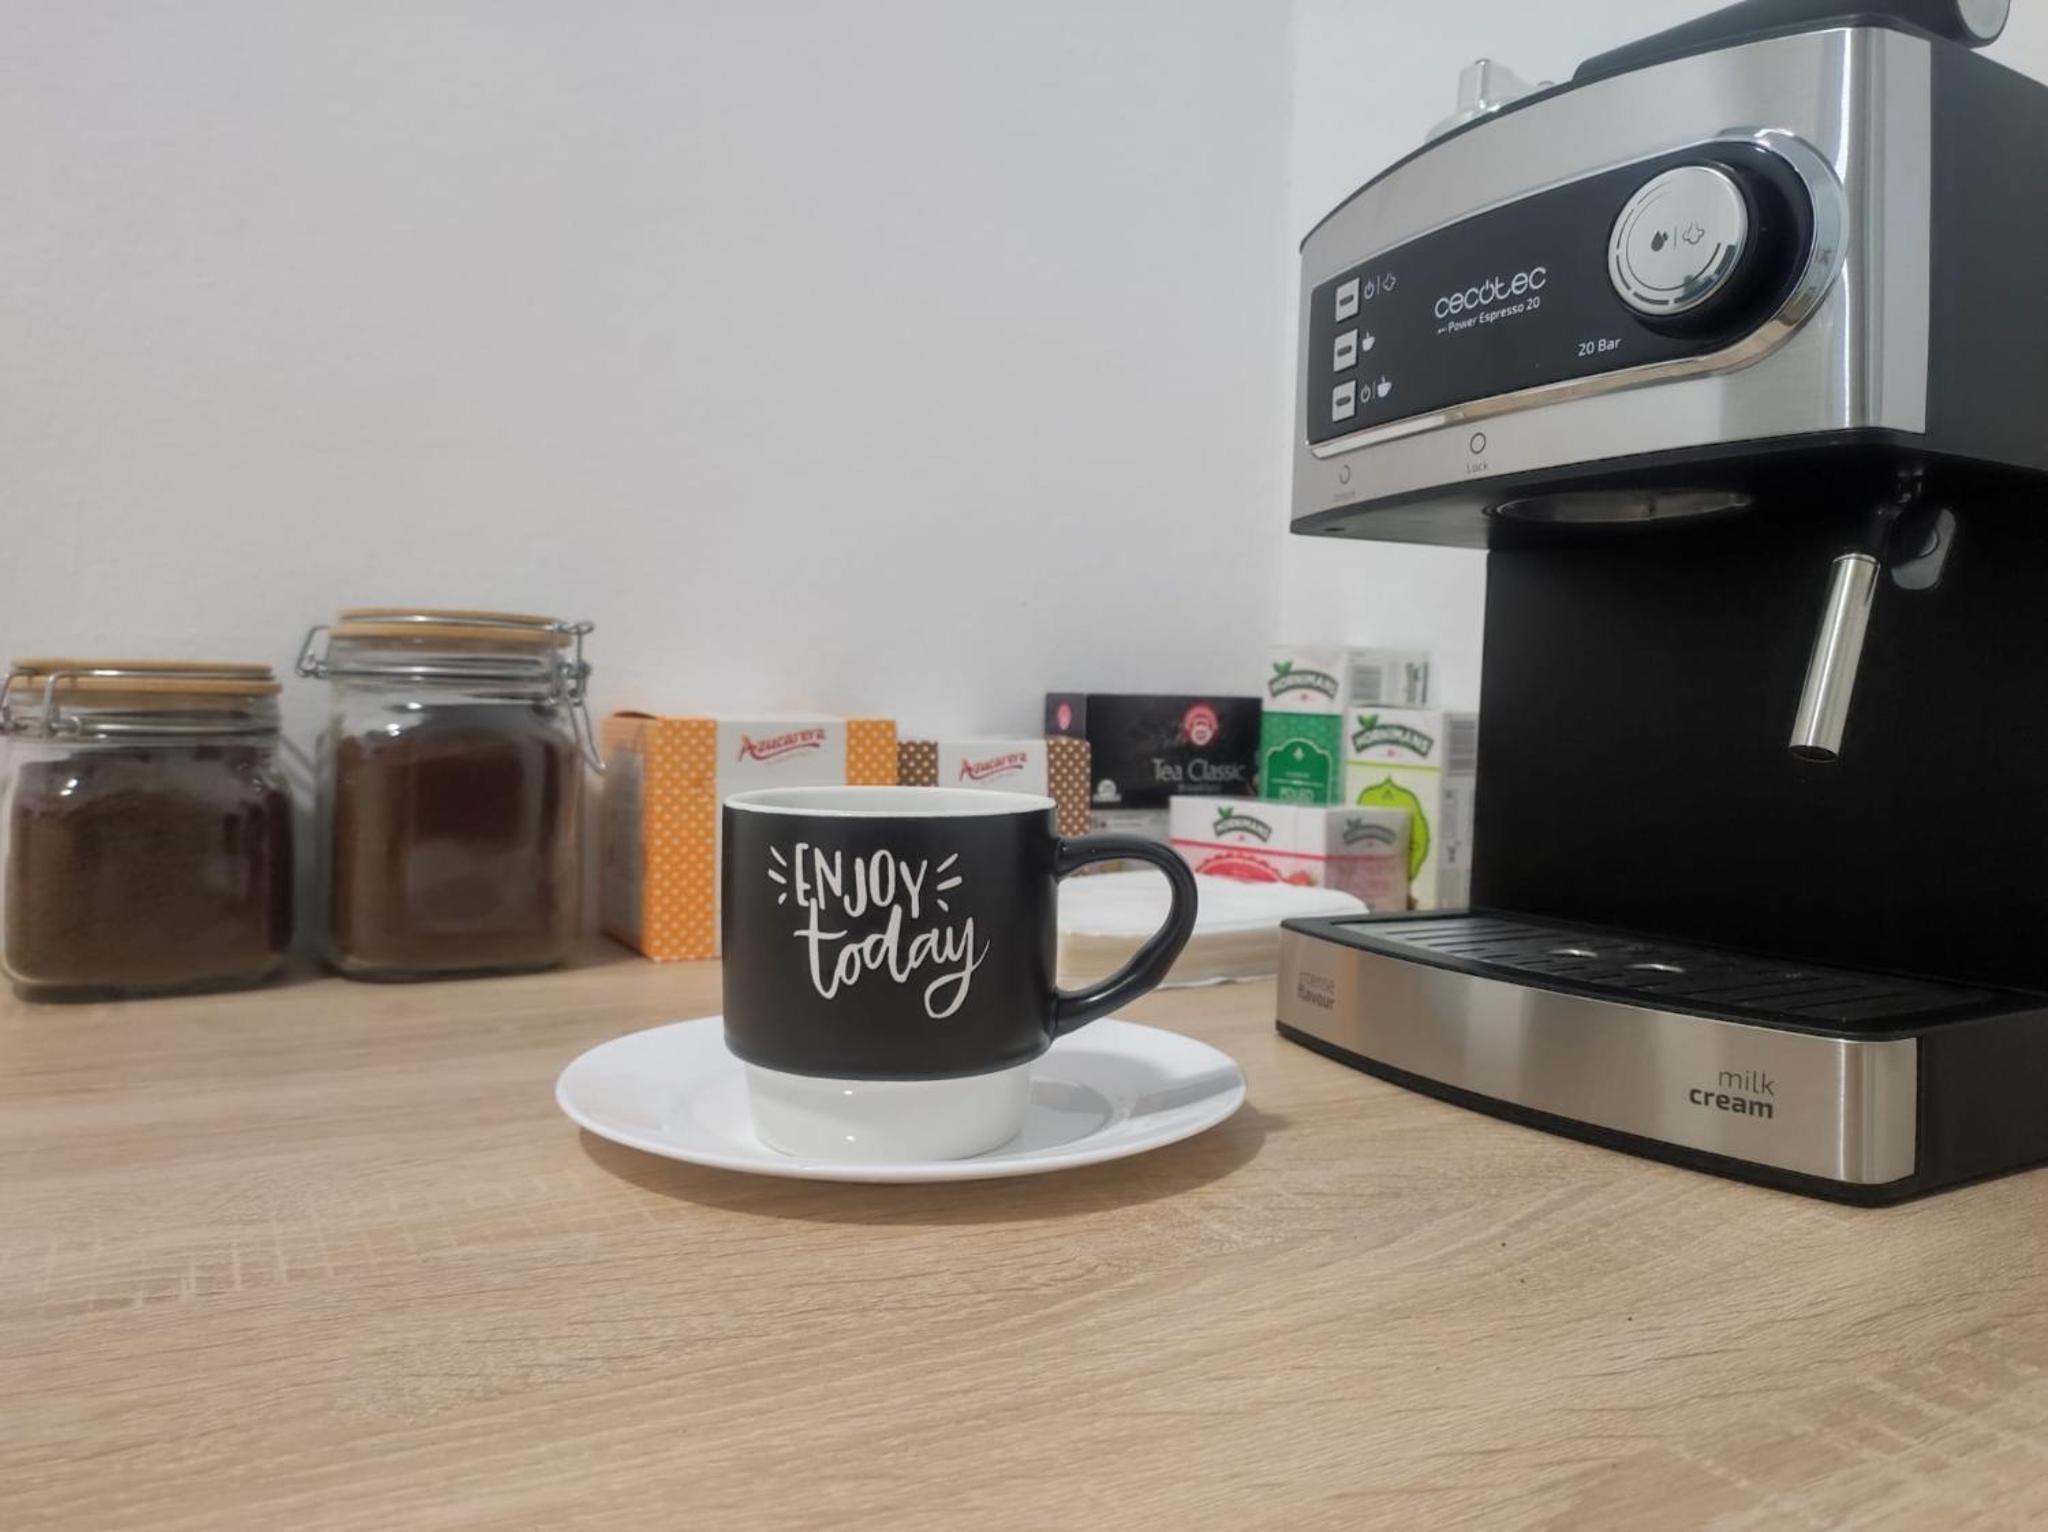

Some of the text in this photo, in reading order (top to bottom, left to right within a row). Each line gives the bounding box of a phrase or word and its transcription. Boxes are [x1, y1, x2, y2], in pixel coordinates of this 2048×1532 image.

[1434, 266, 1546, 318] cecotec
[1447, 296, 1541, 333] Power Espresso 20
[1577, 338, 1622, 357] 20 Bar
[738, 728, 827, 762] Azucarera
[959, 752, 1028, 781] Azucarera
[1152, 758, 1246, 782] Tea Classic
[795, 842, 928, 918] ENJOY
[794, 899, 990, 1019] today
[1718, 1070, 1775, 1096] milk
[1689, 1088, 1774, 1120] cream
